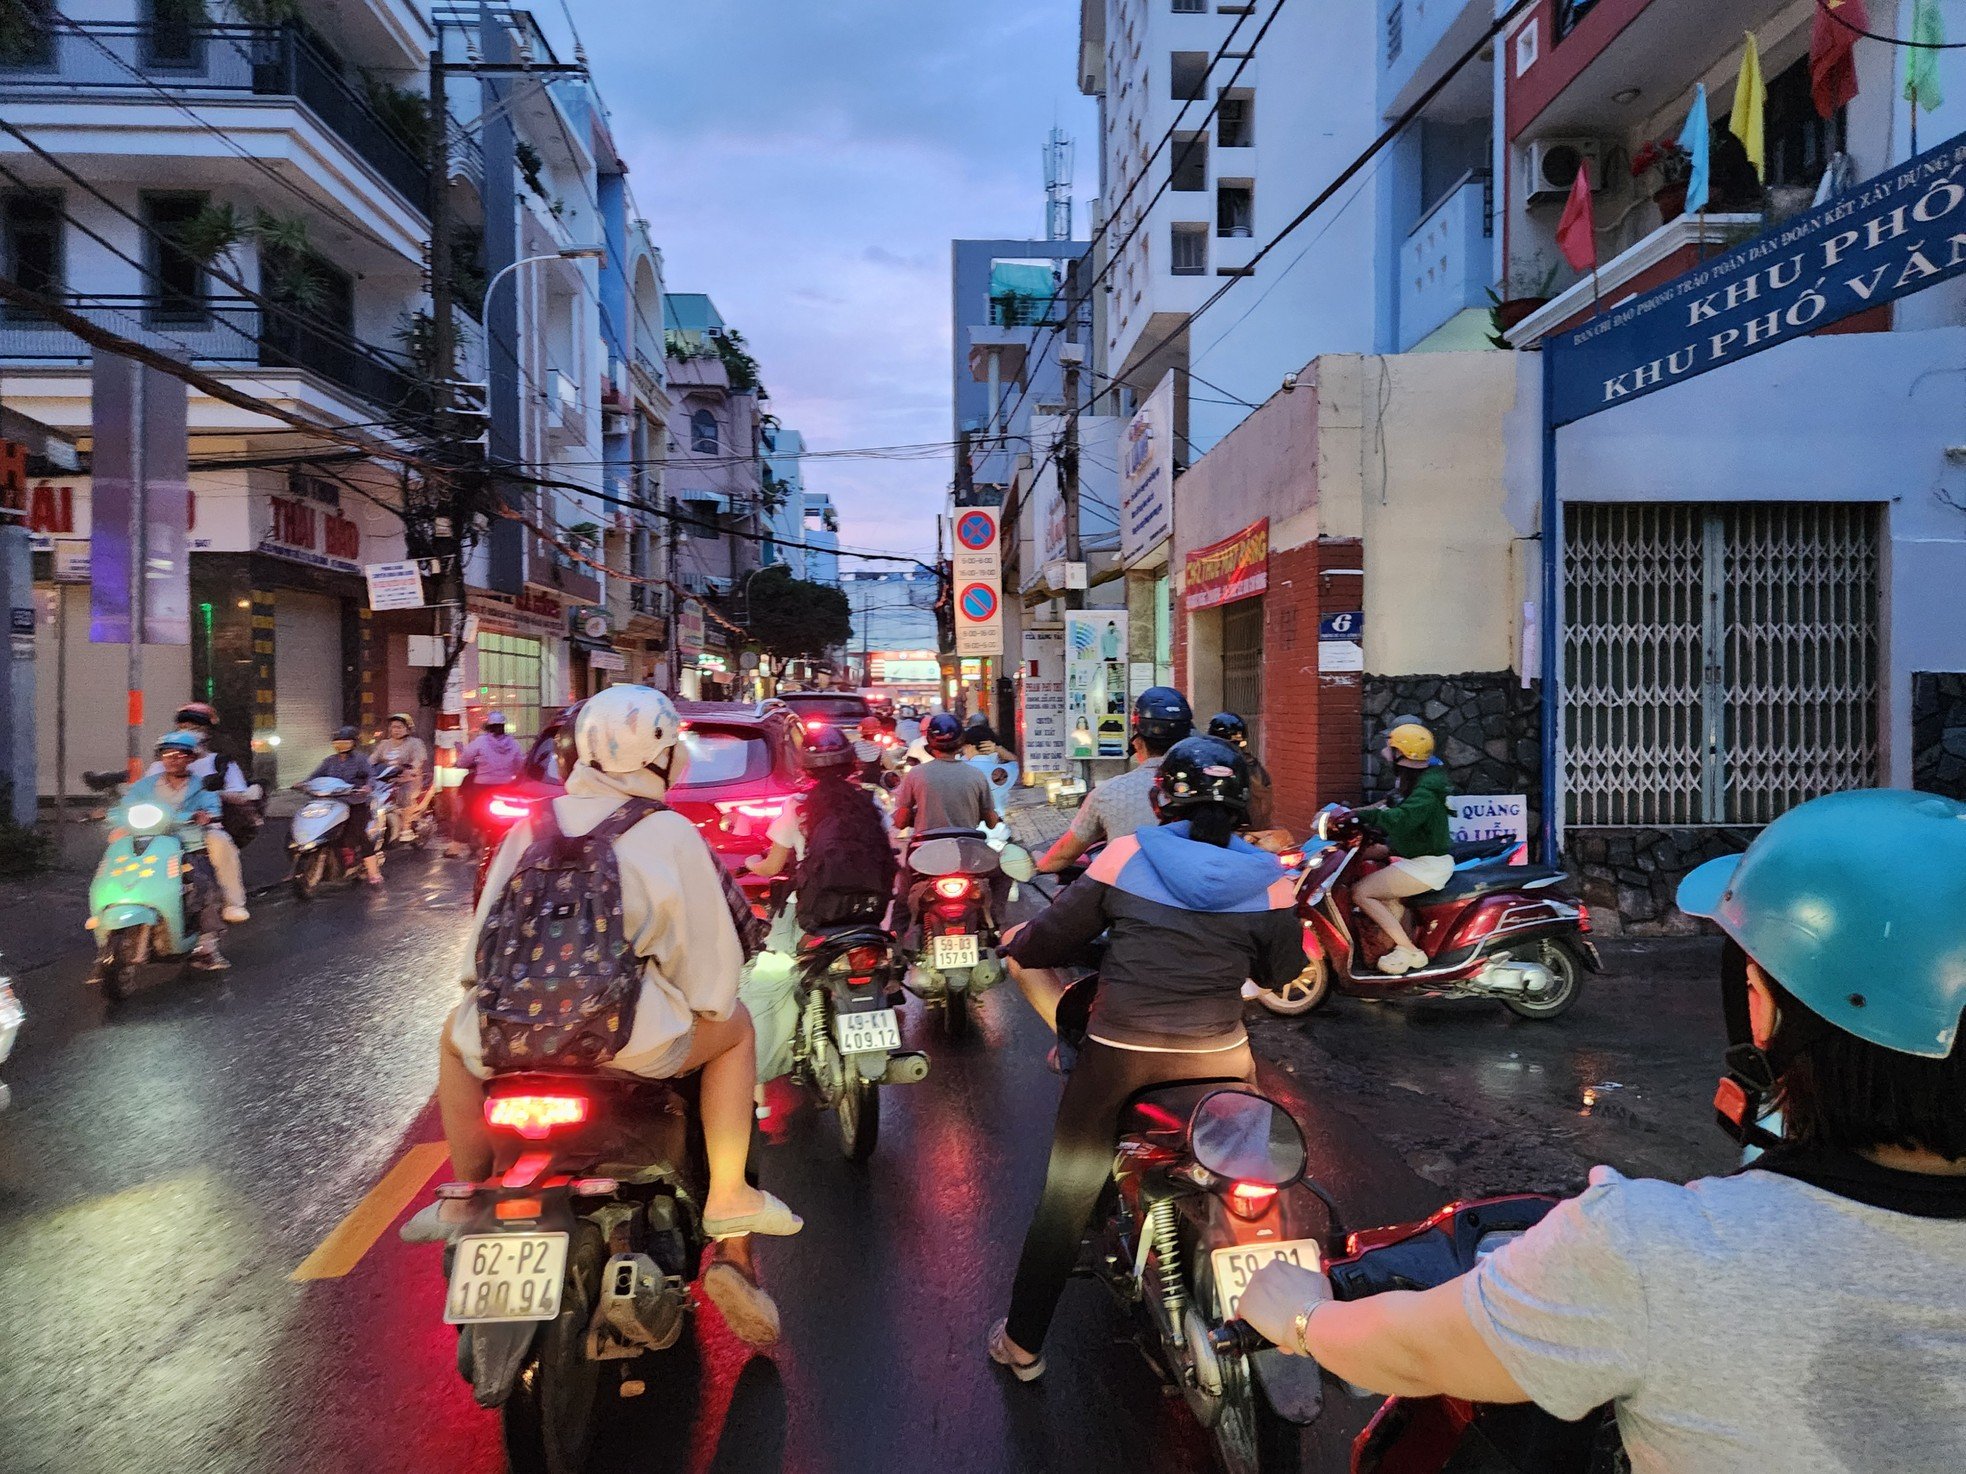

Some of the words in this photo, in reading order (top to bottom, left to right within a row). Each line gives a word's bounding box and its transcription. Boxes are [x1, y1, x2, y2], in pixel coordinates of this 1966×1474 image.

[1636, 288, 1675, 316] PHONG
[1676, 272, 1709, 296] TRÀO
[1712, 252, 1746, 279] TOÀN
[1750, 237, 1778, 262] DÂN
[1781, 214, 1821, 247] ĐOÀN
[1825, 198, 1856, 226] KẾT
[1860, 181, 1894, 210] XÂY
[1898, 153, 1949, 192] DỰNG
[1685, 253, 1806, 328] KHU
[1819, 163, 1965, 270] PHỐ
[1601, 344, 1697, 403] KHU
[1707, 275, 1828, 361] PHỐ
[1331, 613, 1352, 632] 6
[1462, 799, 1521, 820] QUẢNG
[844, 1029, 898, 1050] 409.12
[472, 1240, 550, 1276] 62-P2
